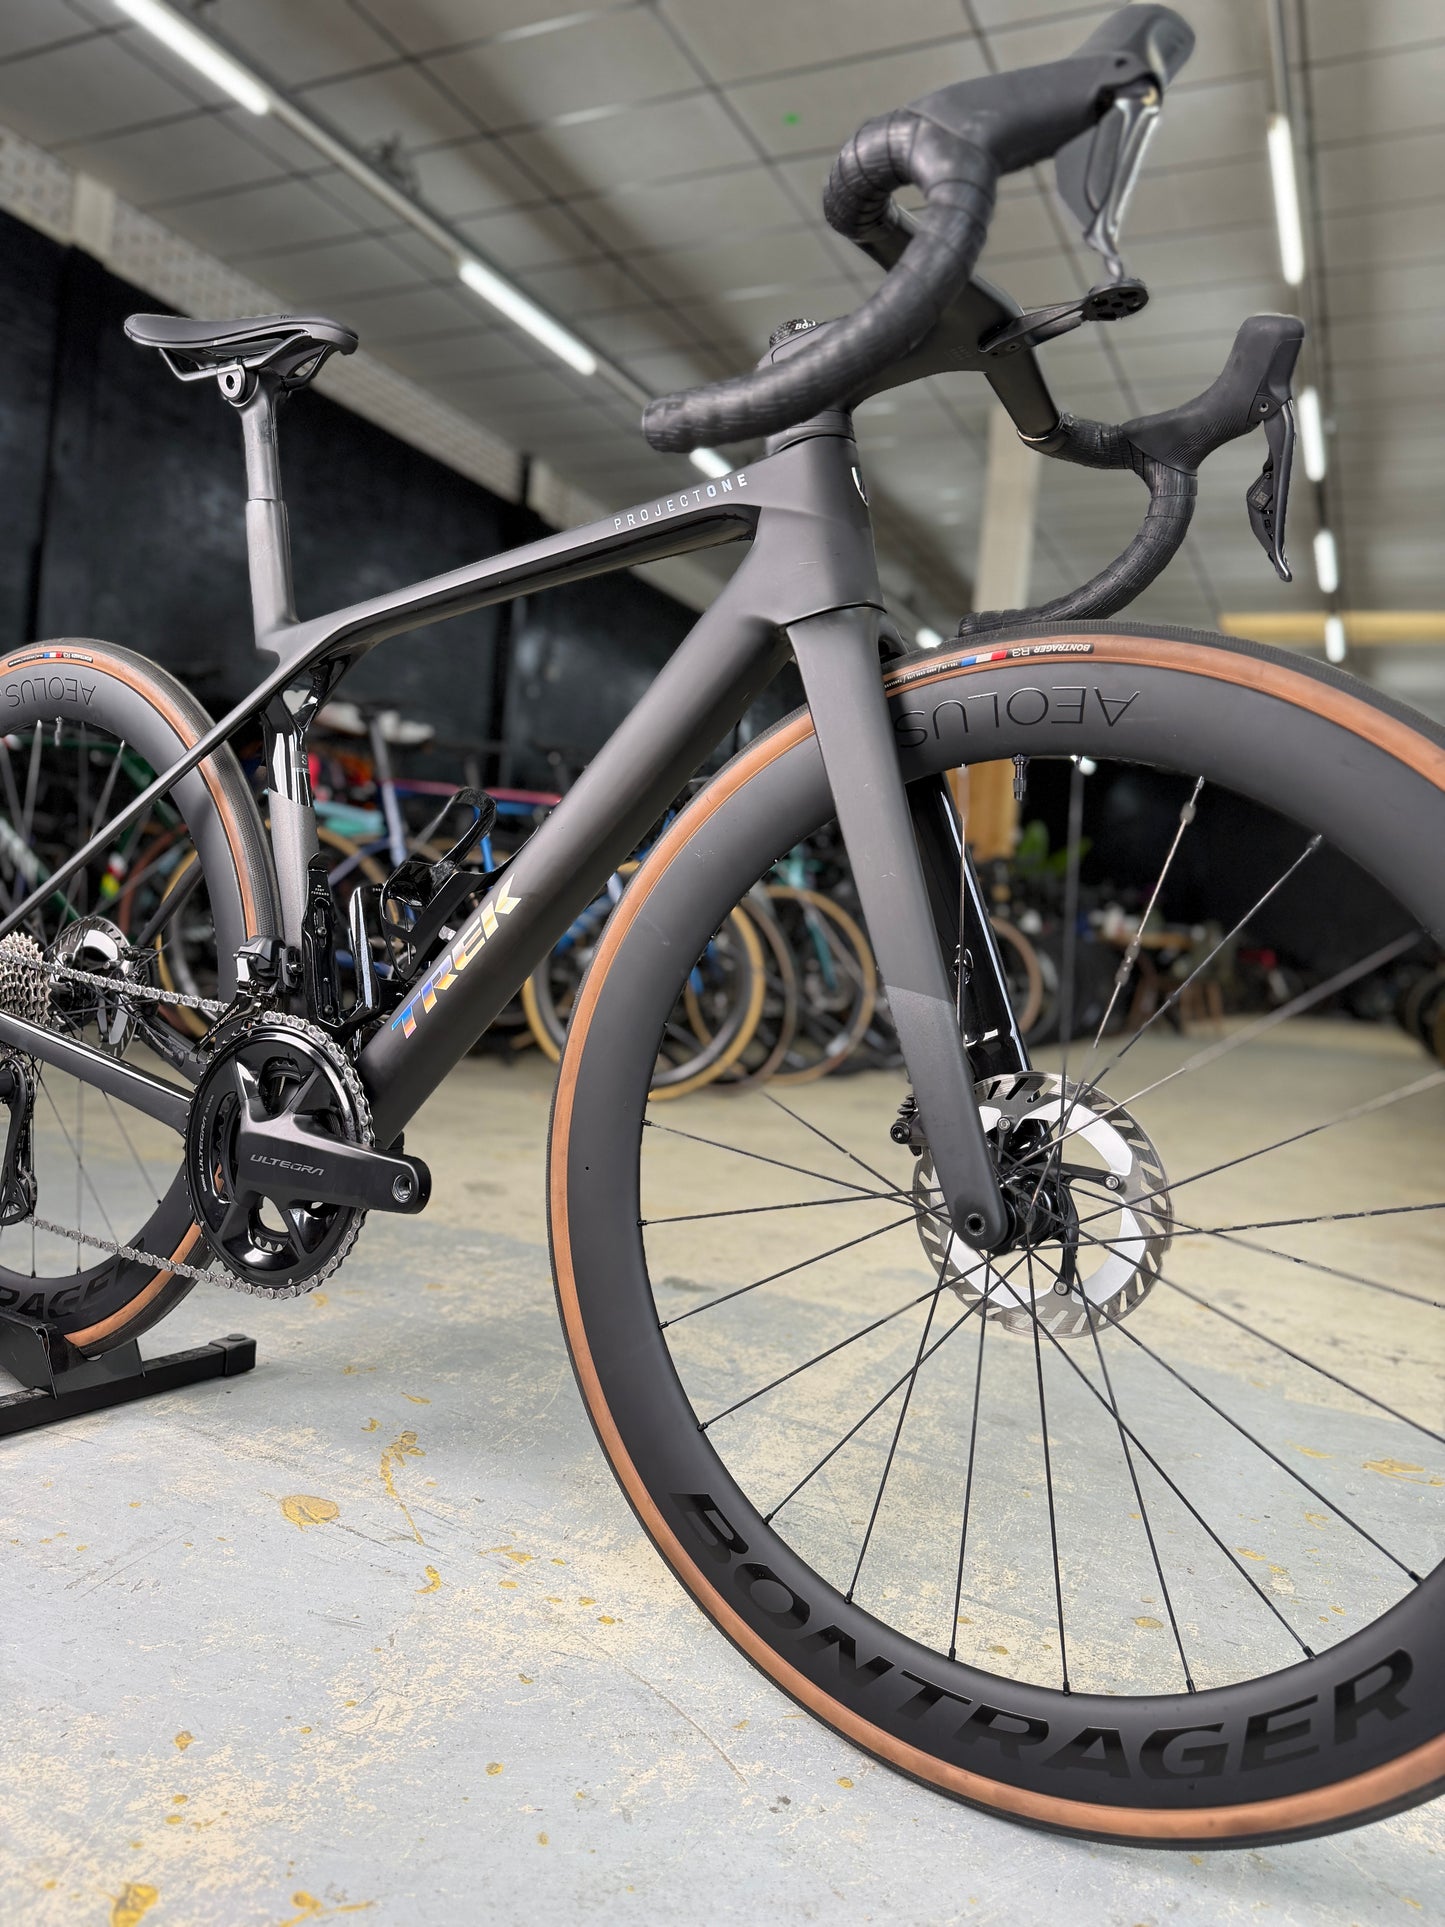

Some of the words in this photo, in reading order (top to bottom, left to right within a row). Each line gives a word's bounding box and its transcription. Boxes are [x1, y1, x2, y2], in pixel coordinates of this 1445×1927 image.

[1011, 647, 1030, 658] R3
[1033, 643, 1091, 654] BONTRAGER
[5, 676, 97, 708] AEOLUS
[894, 686, 1141, 748] AEOLUS
[391, 872, 522, 1039] TREK
[207, 1004, 241, 1037] ULTEGRA
[198, 1116, 207, 1172] ULTEGRA
[250, 1153, 324, 1177] ULTEGRA
[670, 1492, 1414, 1781] BONTRAGER
